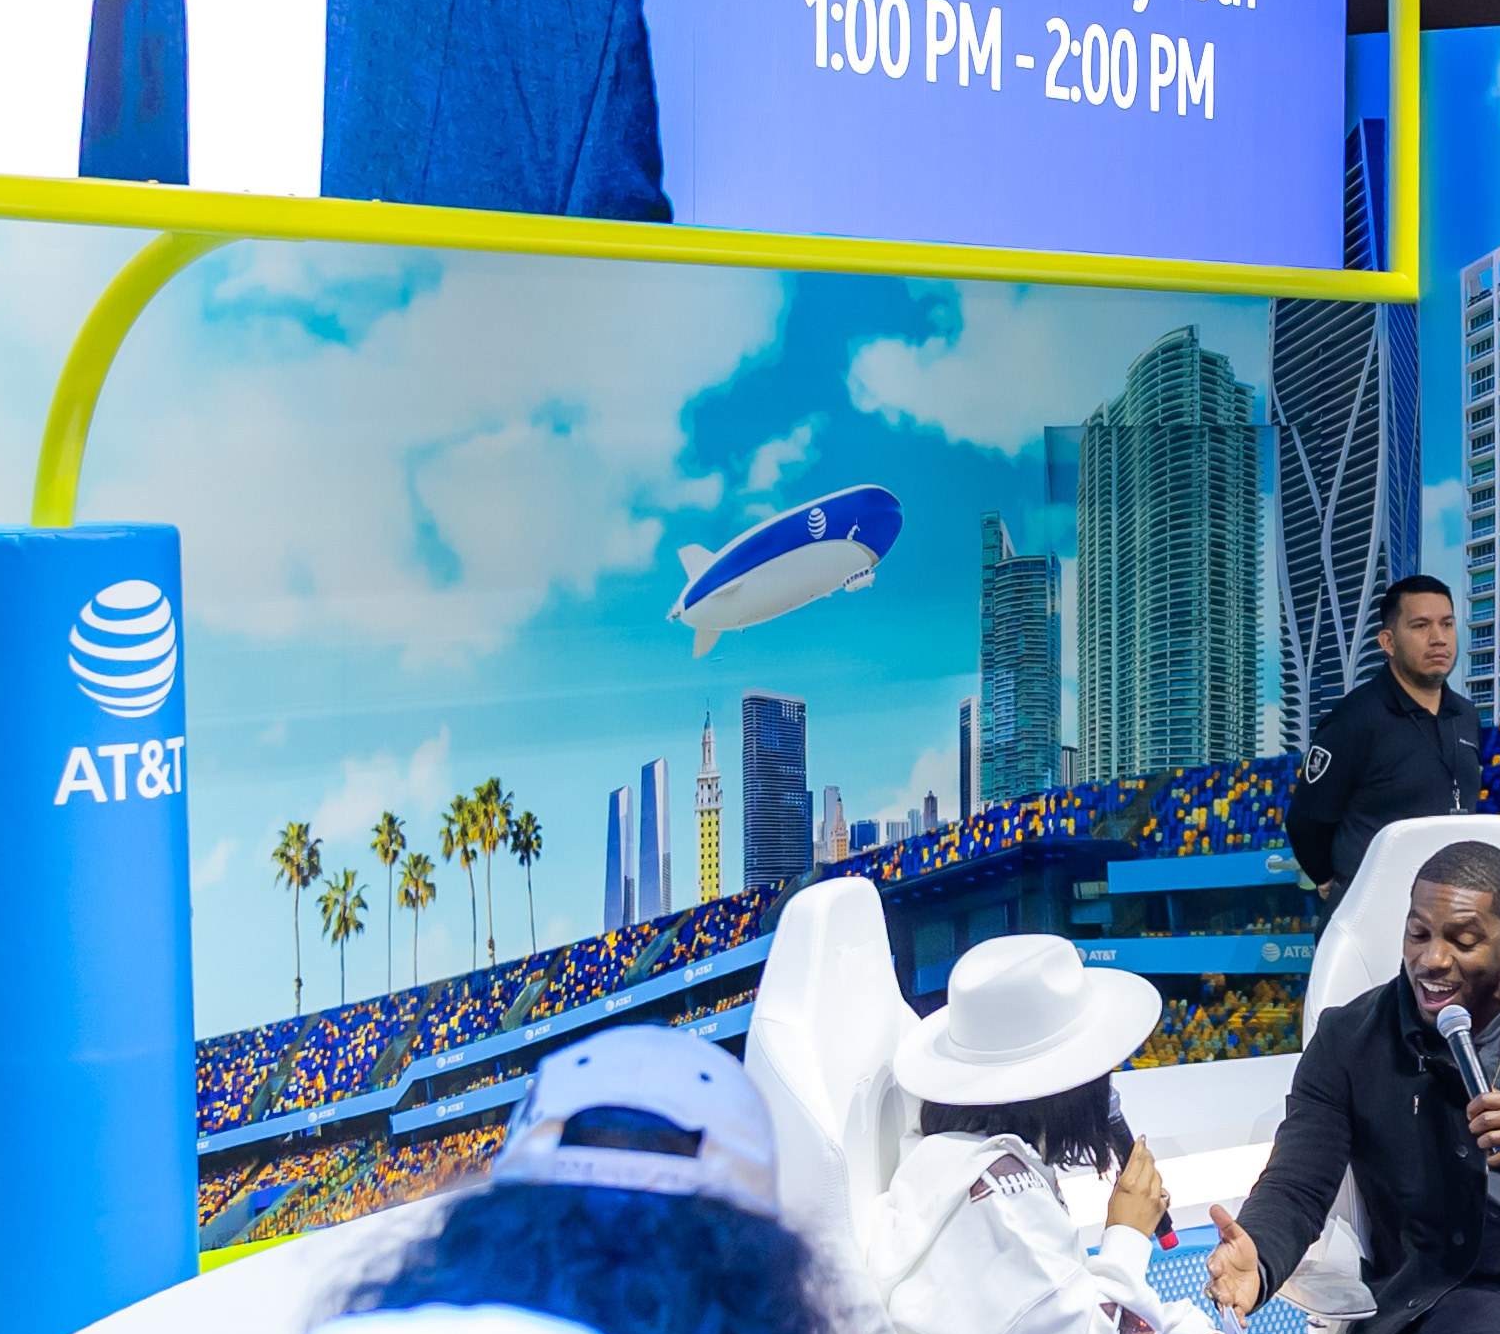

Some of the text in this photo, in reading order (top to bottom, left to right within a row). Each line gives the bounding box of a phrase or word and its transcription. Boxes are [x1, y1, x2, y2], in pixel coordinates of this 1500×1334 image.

[1045, 17, 1137, 110] 2:00
[1150, 32, 1215, 120] PM
[53, 735, 185, 806] AT&T
[1088, 949, 1117, 961] AT&T
